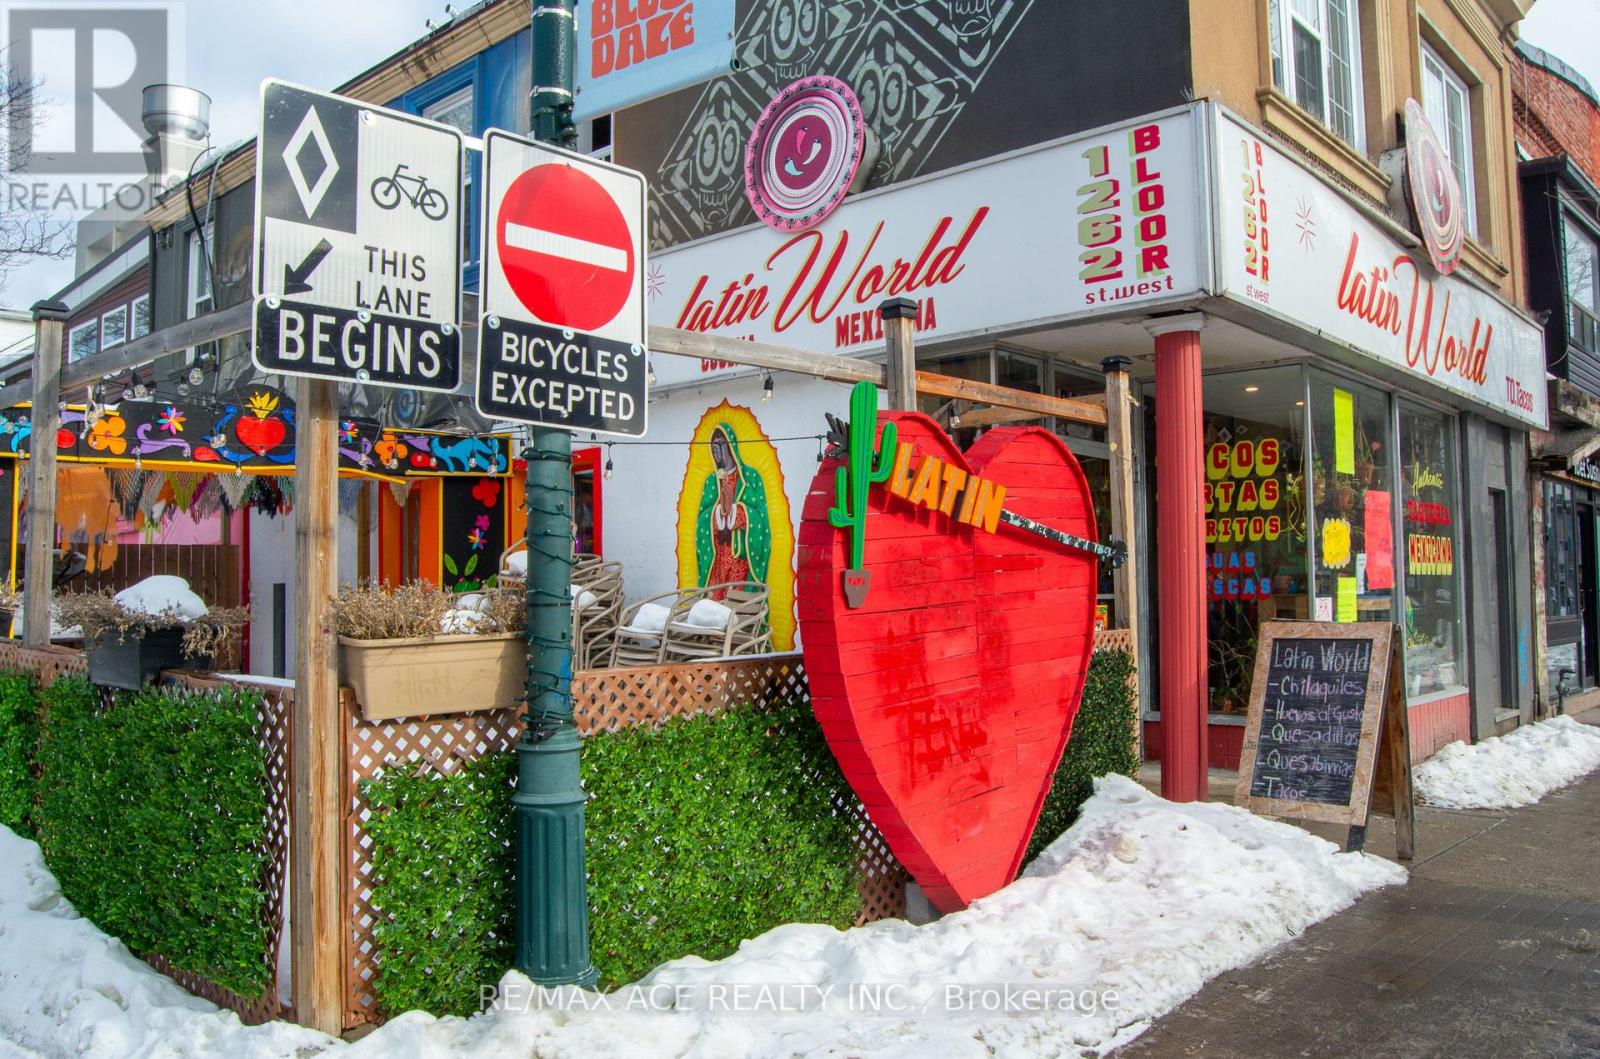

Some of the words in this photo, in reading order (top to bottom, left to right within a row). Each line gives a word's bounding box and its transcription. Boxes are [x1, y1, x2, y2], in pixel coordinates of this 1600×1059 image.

[591, 3, 695, 78] DALE
[1076, 145, 1123, 285] 1262
[1128, 124, 1170, 280] BLOOR
[1241, 139, 1257, 277] 1262
[1253, 141, 1270, 285] BLOOR
[364, 245, 427, 282] THIS
[764, 206, 991, 333] World
[356, 280, 432, 319] LANE
[836, 297, 938, 347] MEXINA
[1393, 255, 1493, 386] World
[278, 309, 441, 379] BEGINS
[501, 330, 629, 383] BICYCLES
[491, 371, 635, 421] EXCEPTED
[1206, 438, 1280, 480] COS
[888, 441, 1007, 535] LATIN
[1204, 478, 1280, 513] RTAS
[1205, 516, 1281, 543] RITOS
[1408, 533, 1453, 575] MEXICANA
[1206, 577, 1272, 601] SCAS
[1274, 641, 1314, 670] Latin
[1320, 641, 1370, 673] World
